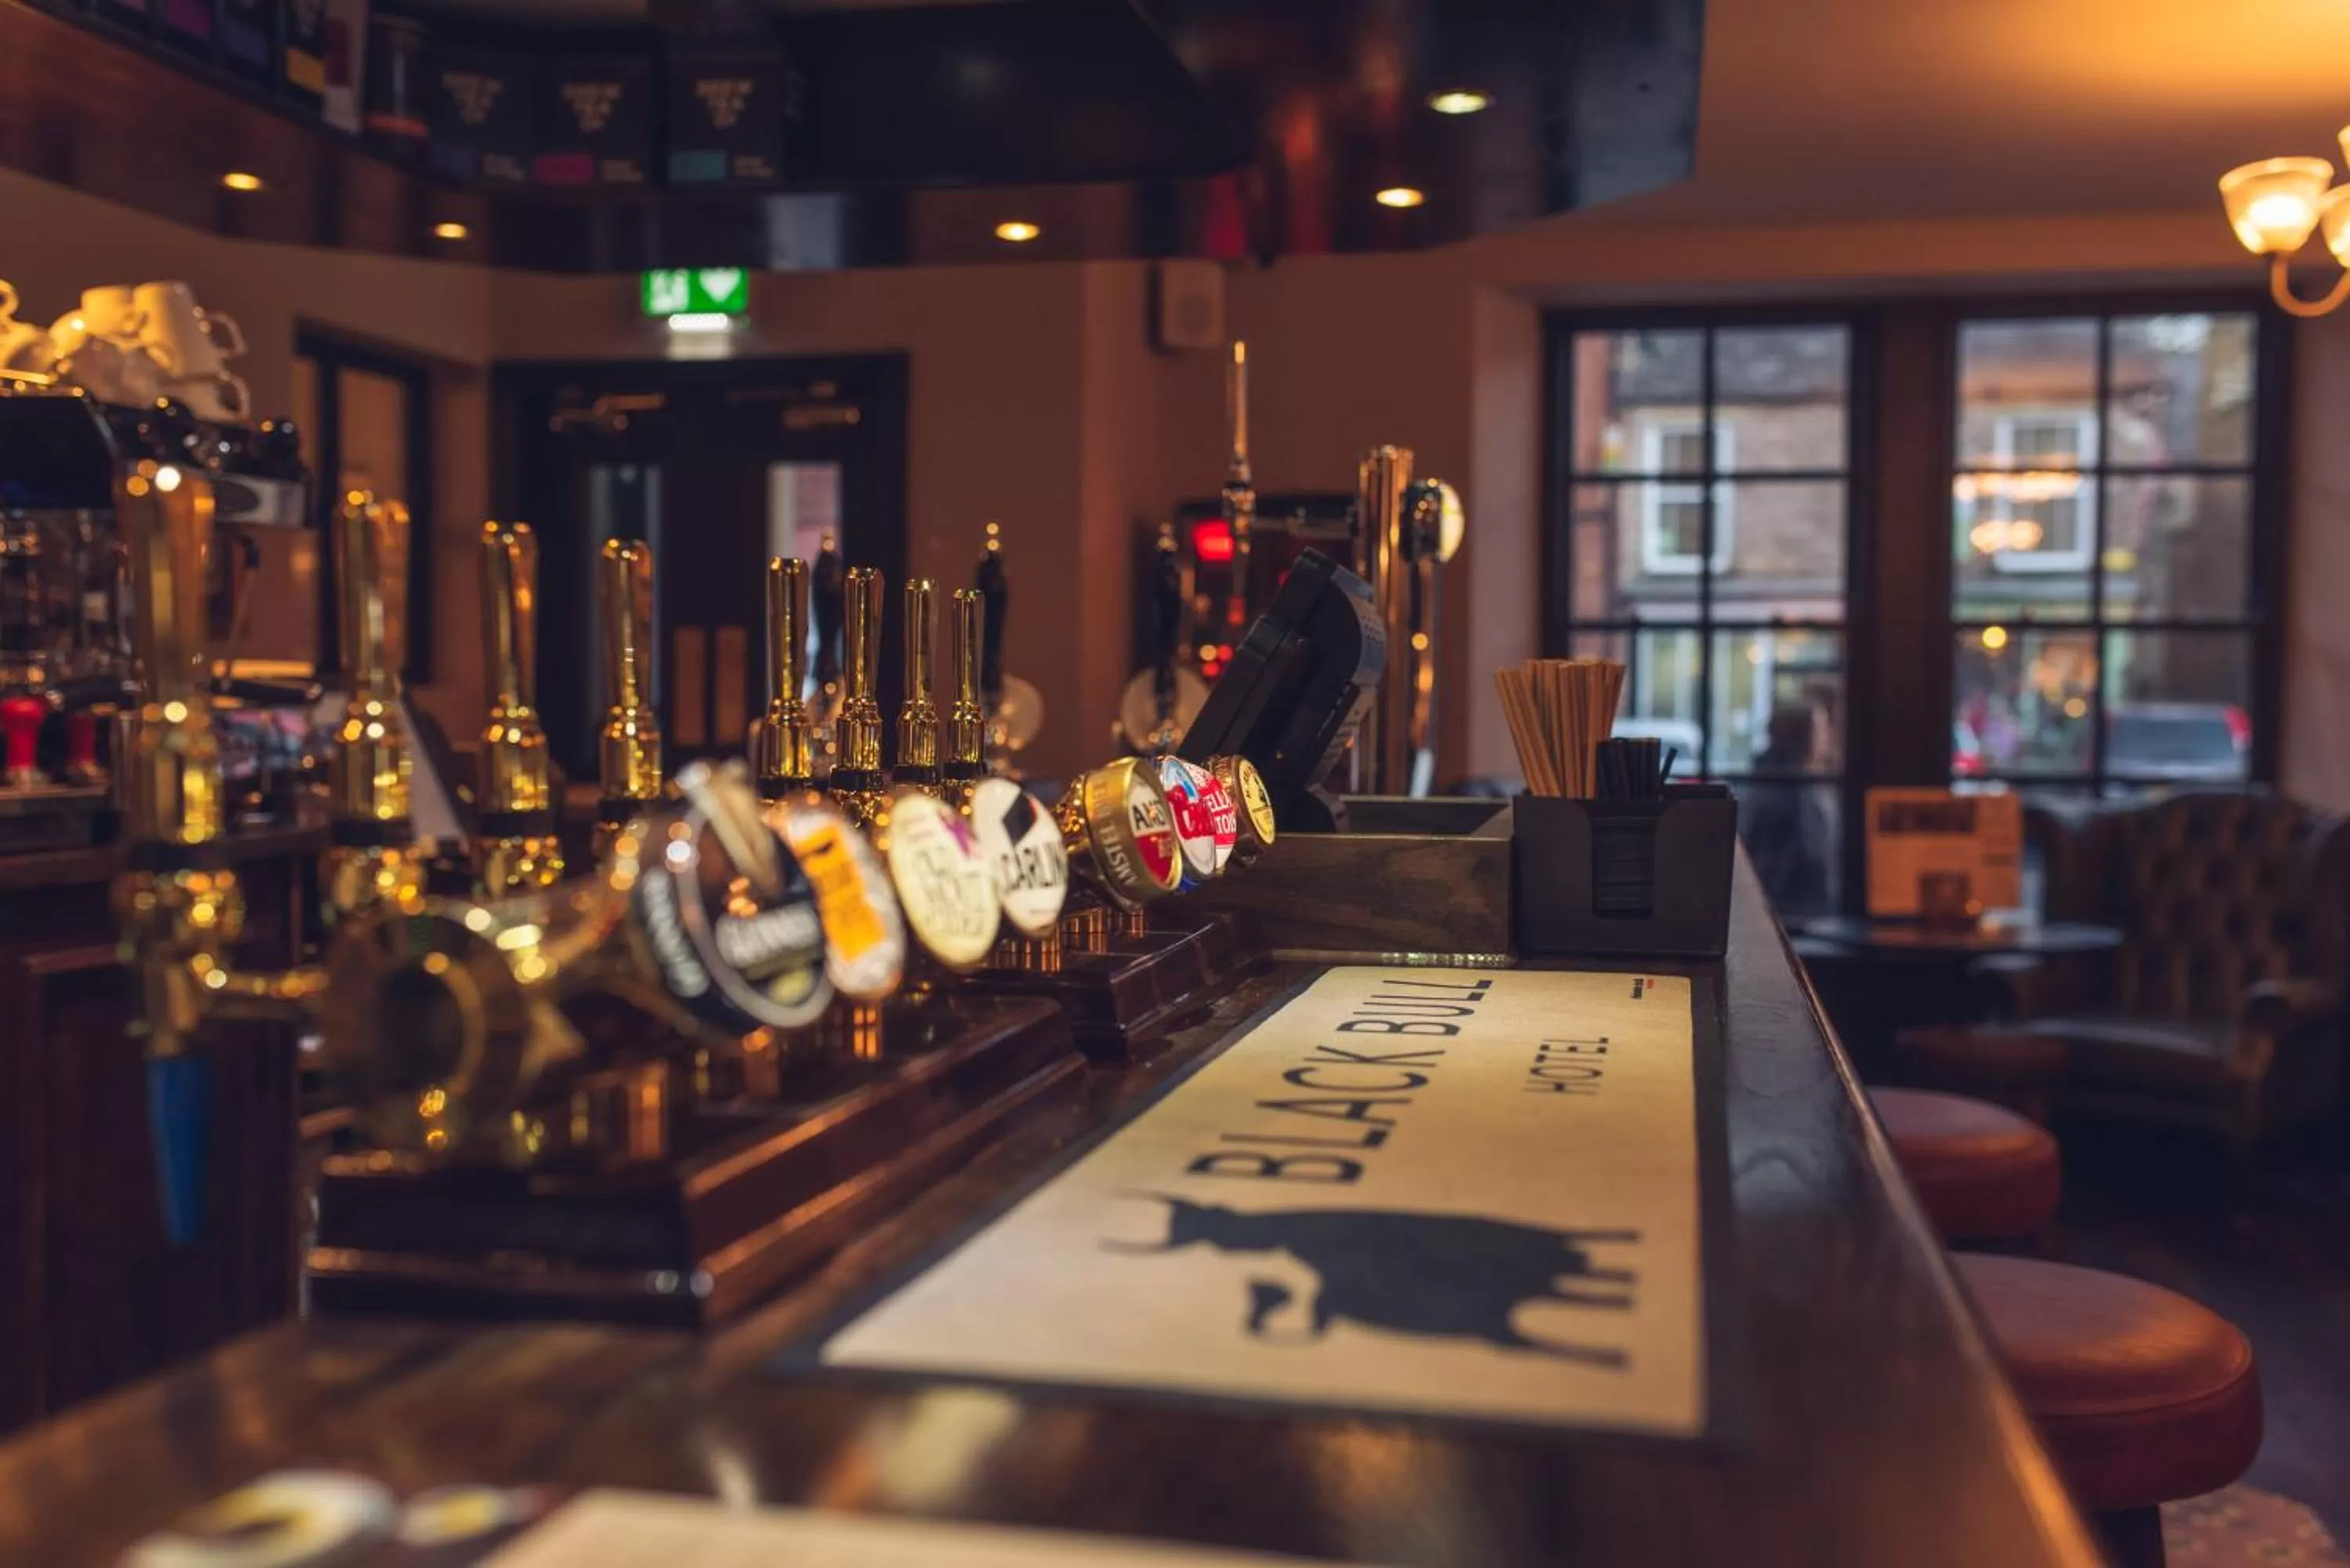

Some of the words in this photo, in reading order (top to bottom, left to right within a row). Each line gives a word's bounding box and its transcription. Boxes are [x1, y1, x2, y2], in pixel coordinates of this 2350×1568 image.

[1185, 1046, 1446, 1183] BLACK
[1335, 979, 1493, 1036] BULL
[1522, 1037, 1610, 1095] HOTEL
